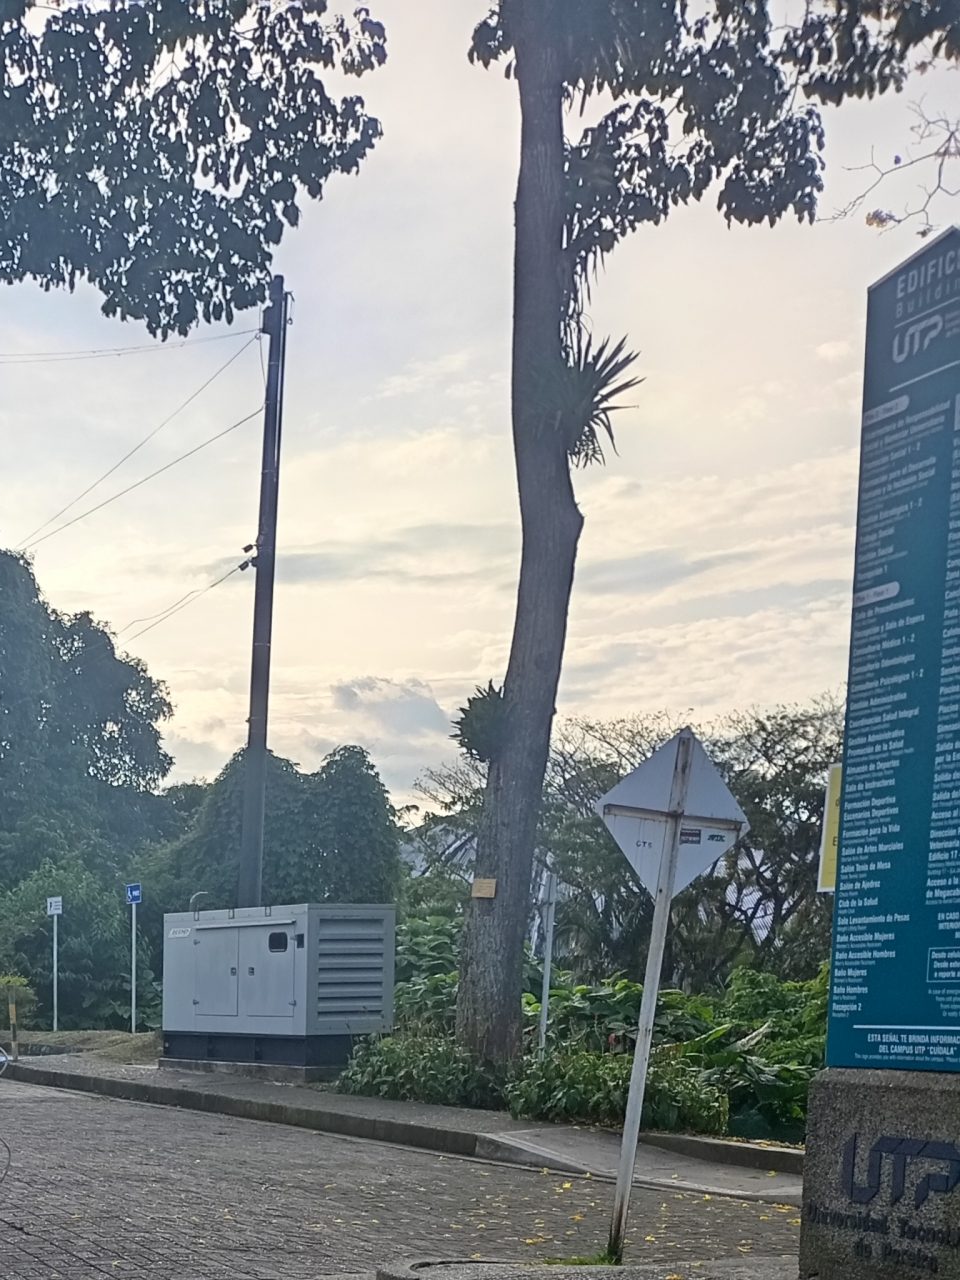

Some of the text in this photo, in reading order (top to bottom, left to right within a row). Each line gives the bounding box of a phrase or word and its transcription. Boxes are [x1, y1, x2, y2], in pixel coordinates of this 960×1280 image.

[892, 314, 944, 364] UTP
[950, 850, 958, 860] 17
[858, 1002, 862, 1011] 2
[867, 1033, 881, 1042] ESTA
[882, 1031, 899, 1043] SEÑAL
[900, 1034, 907, 1043] TE
[908, 1034, 929, 1043] BRINDA
[879, 1044, 889, 1053] DEL
[890, 1044, 913, 1054] CAMPUS
[914, 1045, 926, 1054] UTP
[843, 1132, 960, 1211] UTP
